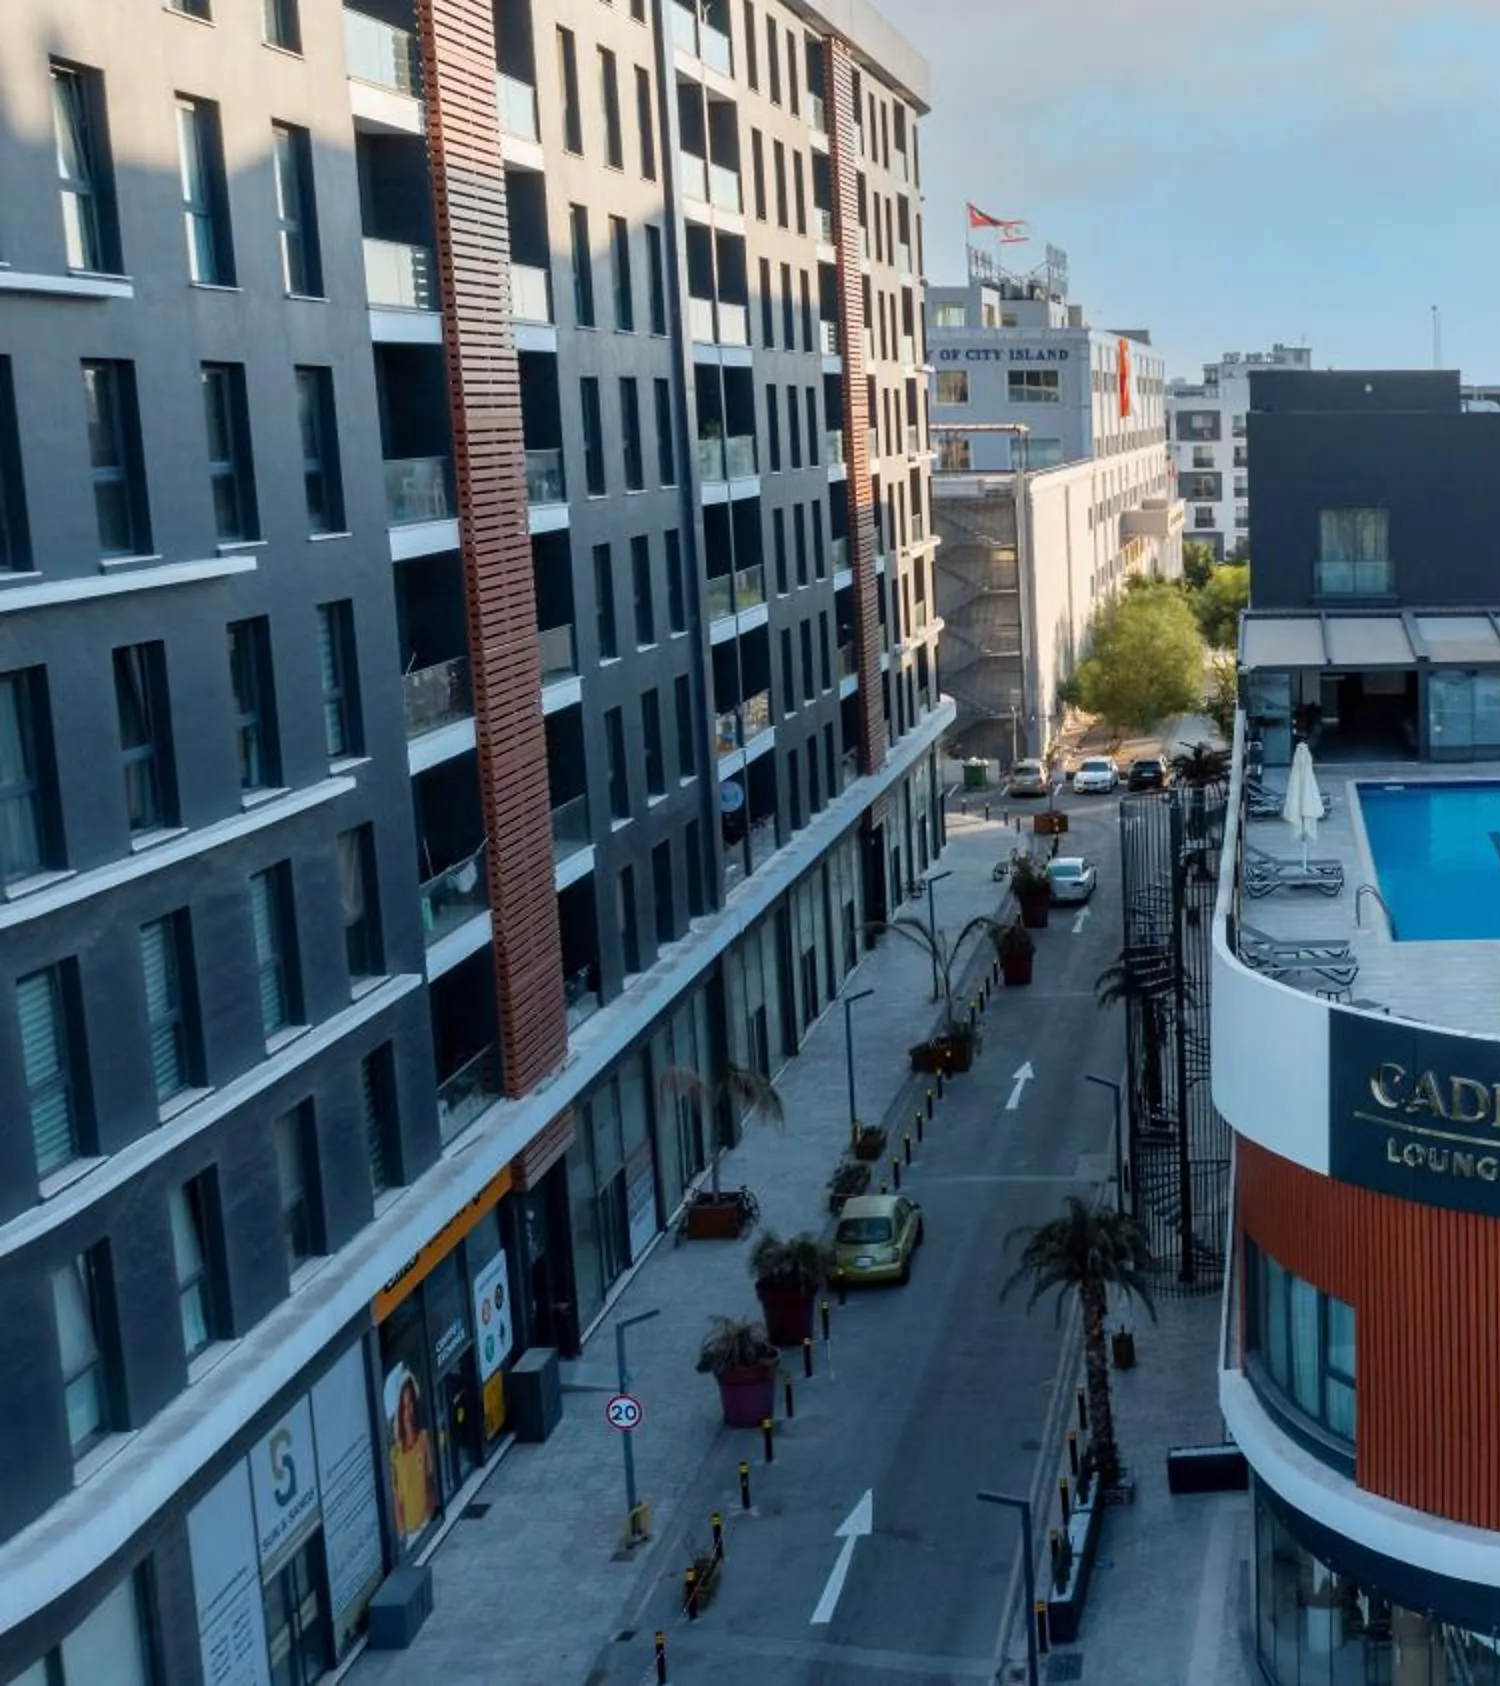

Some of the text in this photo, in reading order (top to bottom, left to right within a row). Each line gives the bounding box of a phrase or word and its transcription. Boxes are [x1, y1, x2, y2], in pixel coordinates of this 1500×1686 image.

[940, 348, 961, 361] OF
[965, 348, 1001, 361] CITY
[1008, 348, 1069, 361] ISLAND
[611, 1405, 637, 1421] 20
